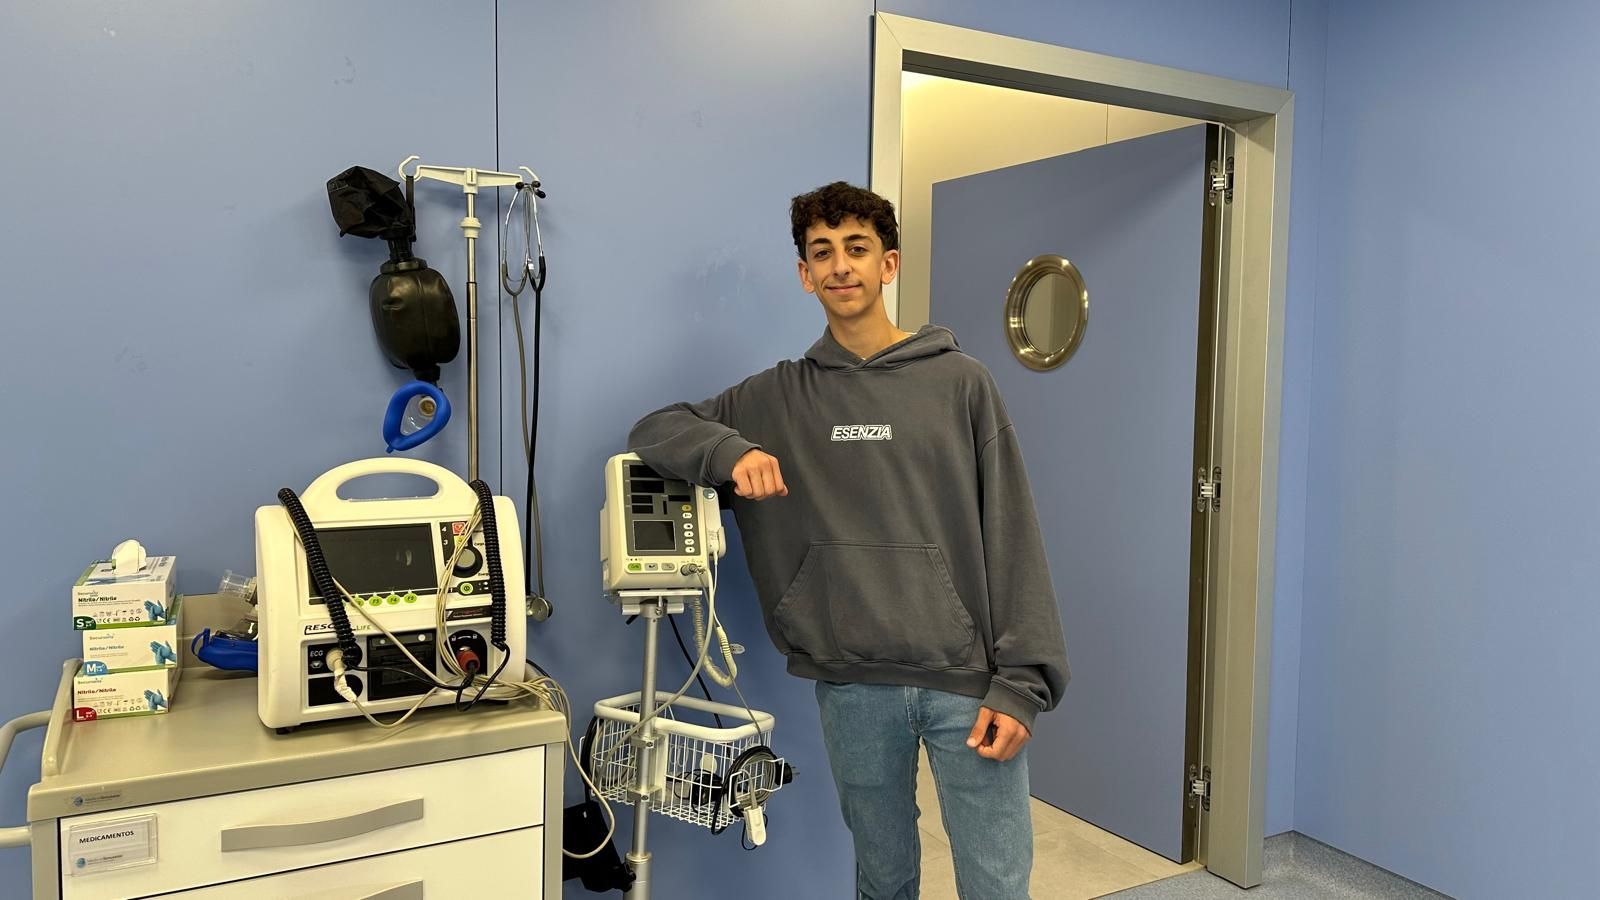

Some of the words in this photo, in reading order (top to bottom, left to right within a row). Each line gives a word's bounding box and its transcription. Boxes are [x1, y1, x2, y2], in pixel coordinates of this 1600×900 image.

[831, 425, 892, 440] ESENZIA
[76, 619, 85, 628] S
[86, 663, 97, 674] M
[76, 710, 84, 719] L
[79, 830, 134, 844] MEDICAMENTOS
